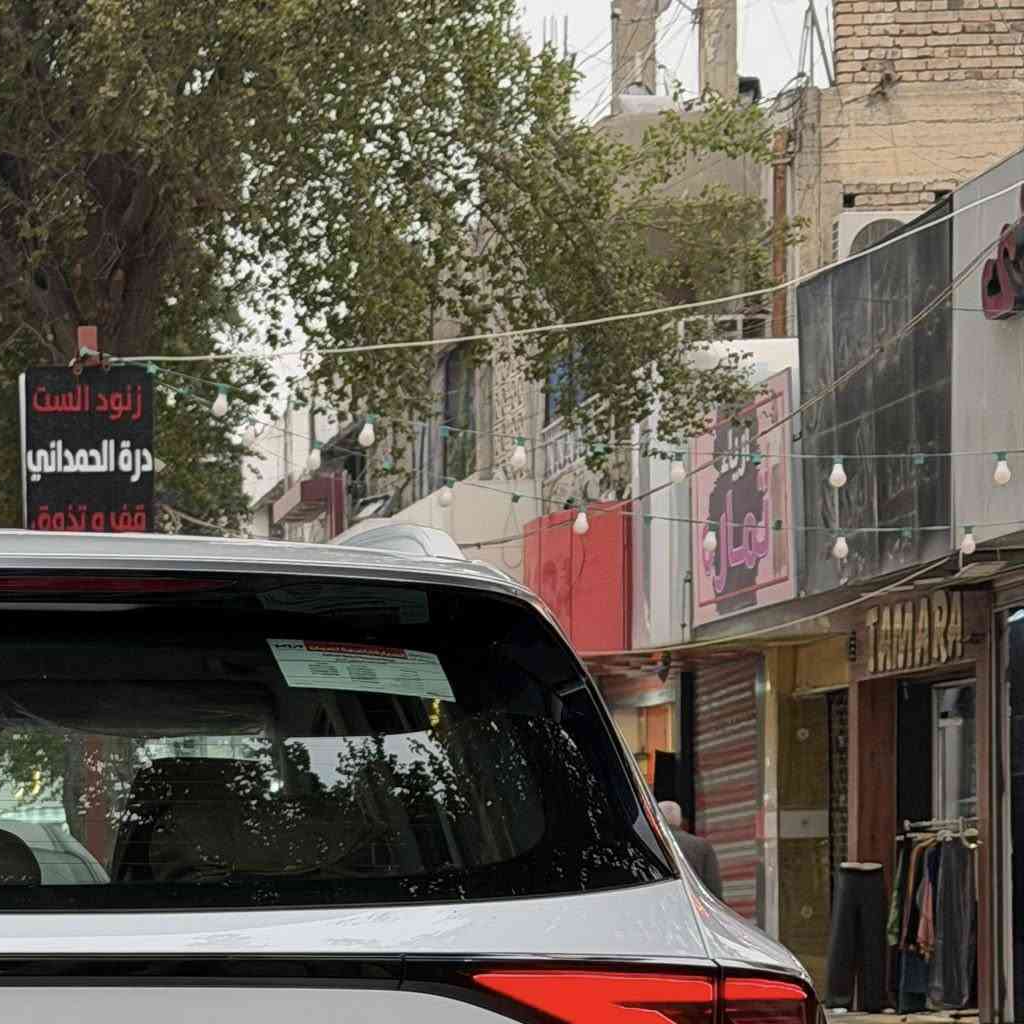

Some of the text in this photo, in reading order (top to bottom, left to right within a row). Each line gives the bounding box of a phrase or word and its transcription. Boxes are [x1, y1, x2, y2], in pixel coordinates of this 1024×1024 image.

[31, 383, 143, 421] زنود الست
[27, 439, 154, 483] درة الحمداني
[865, 590, 963, 673] TAMARA
